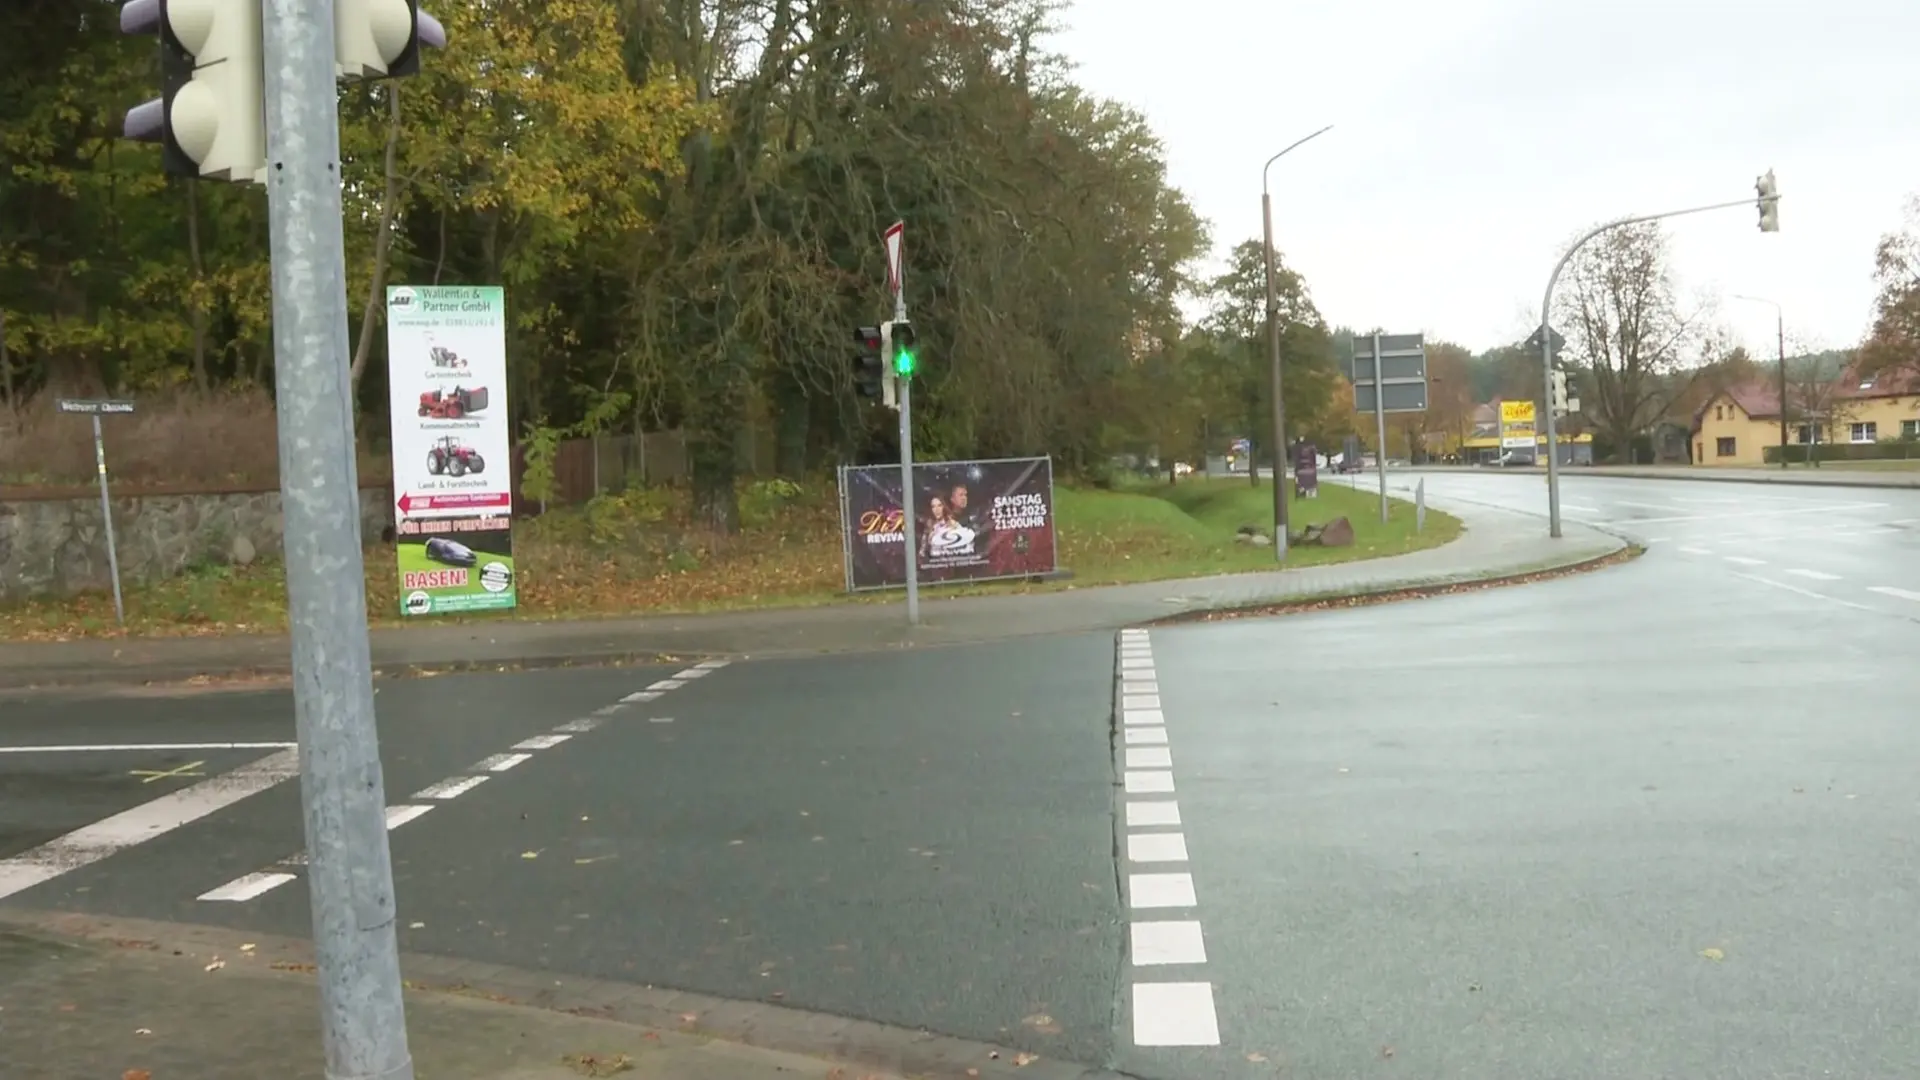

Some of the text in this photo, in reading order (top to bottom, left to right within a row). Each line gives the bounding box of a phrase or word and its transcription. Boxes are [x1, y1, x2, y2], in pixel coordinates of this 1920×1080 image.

[423, 288, 481, 300] Wallentin &
[423, 301, 491, 313] Partner GmbH
[993, 493, 1042, 508] SAMSTAG
[991, 504, 1047, 519] 15.11.2025
[995, 516, 1045, 530] 21:00UHR
[867, 532, 905, 544] REVIVA
[404, 568, 468, 589] RASEN!
